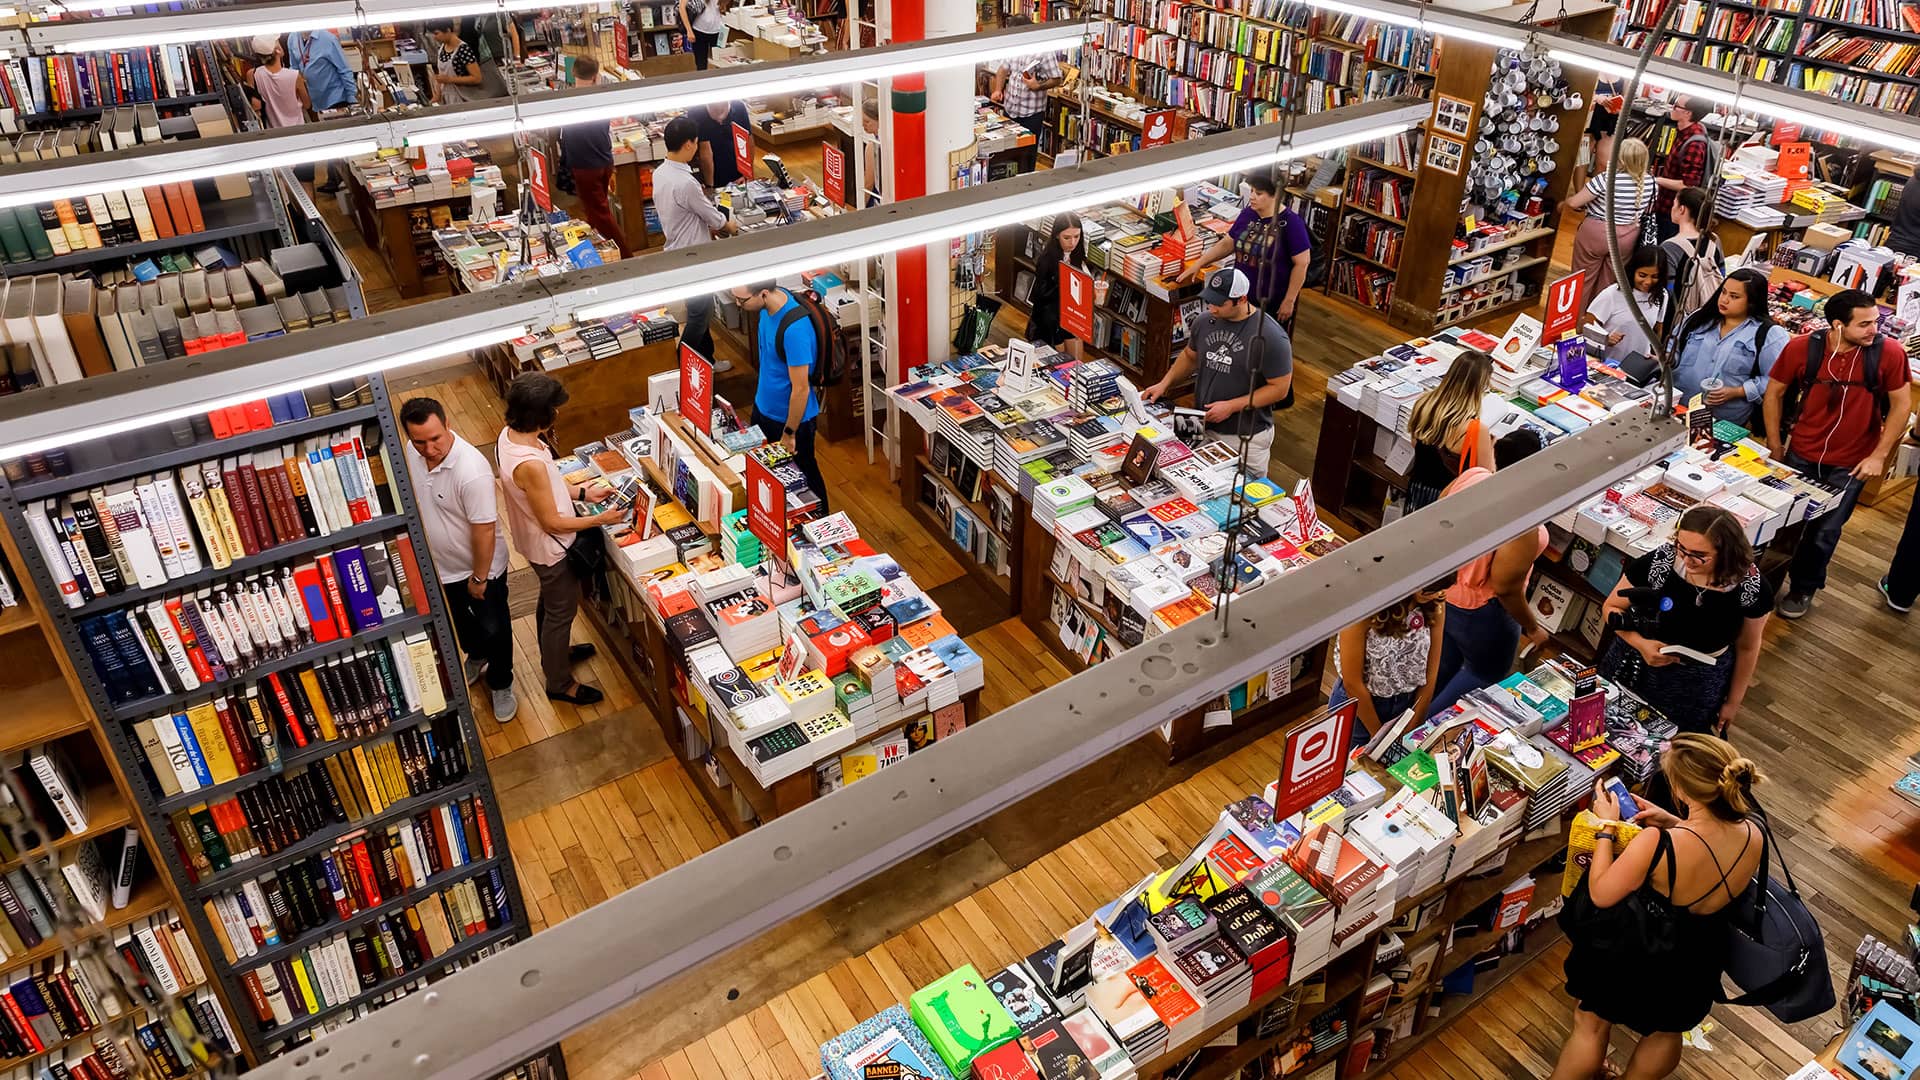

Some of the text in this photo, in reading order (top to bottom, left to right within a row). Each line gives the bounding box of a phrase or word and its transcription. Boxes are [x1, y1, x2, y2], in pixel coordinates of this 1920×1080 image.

[1512, 327, 1534, 341] Obscura
[1521, 324, 1533, 334] Atlas
[225, 474, 246, 513] ZEITOUN
[241, 468, 261, 506] ZEITOUN
[259, 475, 275, 504] ZEITOUN
[269, 473, 284, 502] ZEITOUN
[278, 471, 294, 500] ZEITOUN
[96, 501, 123, 551] THE POLITICIAN
[224, 524, 236, 542] TIMOTHY
[61, 539, 85, 577] OVERREACH
[208, 534, 224, 563] TIMOTHY EGAN
[79, 548, 90, 563] WORST
[85, 562, 96, 577] HARD
[91, 576, 101, 588] TIME
[351, 559, 368, 594] EISENHOWER
[391, 552, 407, 584] EISENHOWER
[326, 576, 342, 606] IKE'S BLUFF
[1541, 584, 1565, 604] Obscura
[1547, 582, 1562, 594] Atlas
[159, 625, 188, 675] IKE & DICK
[276, 690, 294, 718] IKE'S BLUFF
[167, 742, 190, 772] IKE
[179, 725, 195, 751] Eisenhower
[191, 756, 205, 777] President
[884, 744, 898, 758] NW
[1290, 778, 1313, 794] BANNED
[1256, 867, 1292, 891] SHRUGGED
[1261, 859, 1284, 878] ATLAS
[1343, 867, 1378, 893] AYN RAND
[1211, 893, 1249, 914] Valley
[1151, 915, 1176, 941] CARRIE
[1230, 909, 1262, 930] of the
[1242, 922, 1275, 945] Dolls
[142, 935, 175, 991] MONEY POWER
[866, 1066, 899, 1076] BANNED
[982, 1059, 1031, 1080] Beloved
